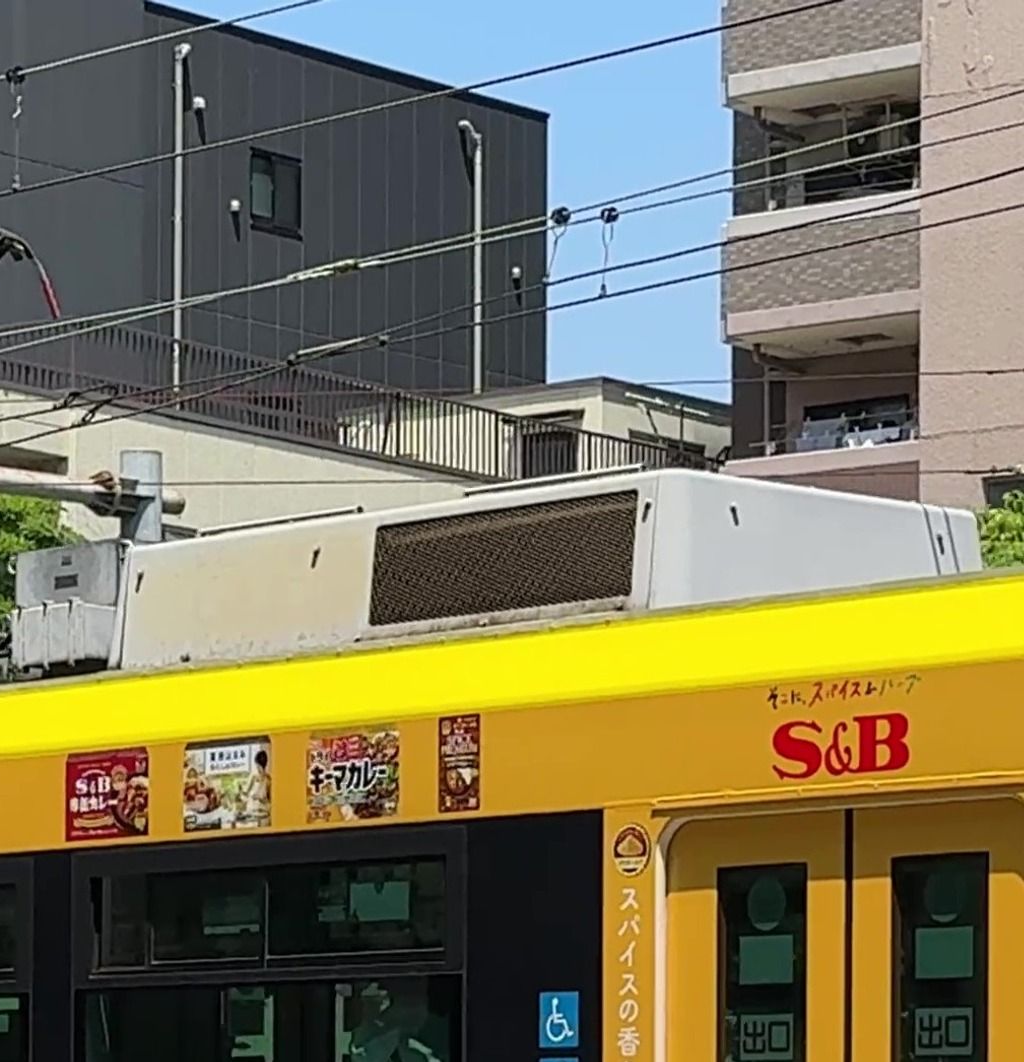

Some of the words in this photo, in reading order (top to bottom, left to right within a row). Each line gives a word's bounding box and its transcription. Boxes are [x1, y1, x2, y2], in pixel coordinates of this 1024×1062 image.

[772, 713, 909, 780] S&B
[310, 760, 388, 793] キーマカレー
[743, 1020, 791, 1054] 出口
[918, 1013, 970, 1049] 出口
